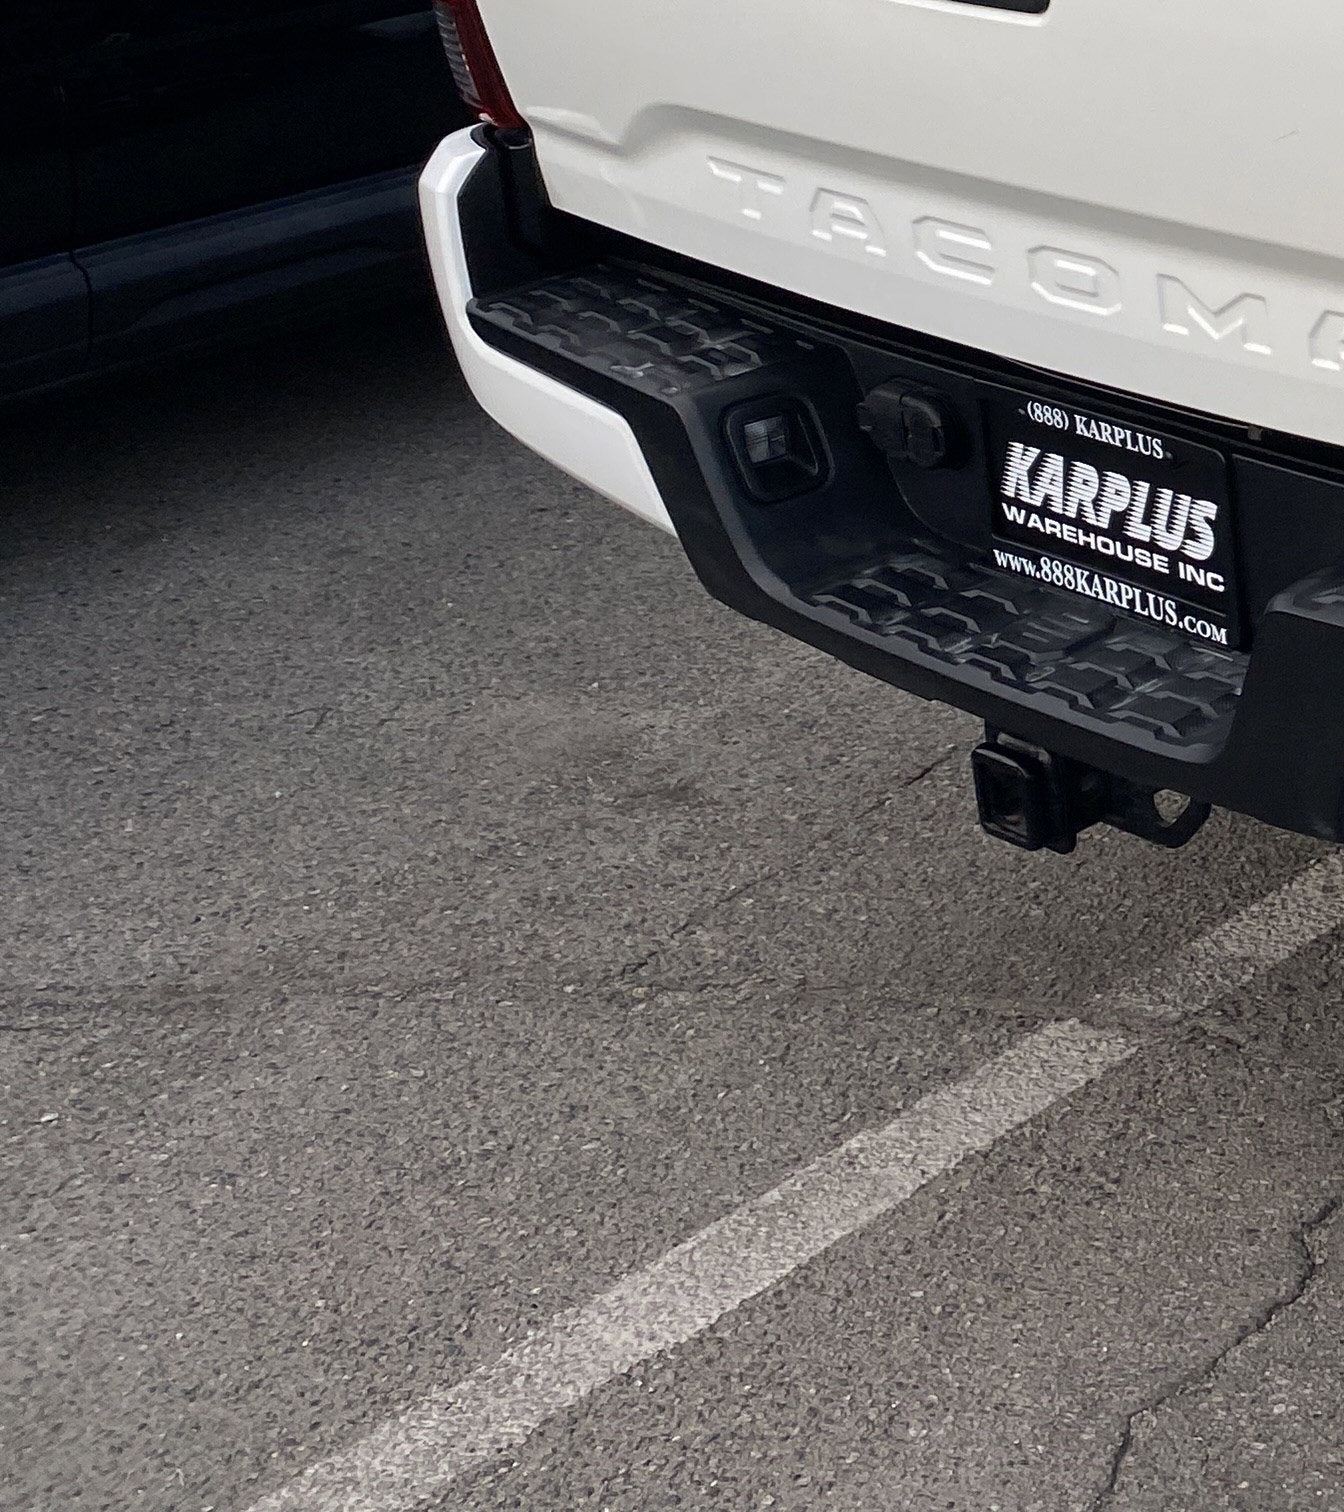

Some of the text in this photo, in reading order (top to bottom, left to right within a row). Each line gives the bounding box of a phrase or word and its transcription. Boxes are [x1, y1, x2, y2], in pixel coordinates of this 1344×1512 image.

[1026, 400, 1164, 459] (888) KARPLUS
[999, 441, 1218, 561] KARPLUS
[1000, 502, 1226, 593] WAREHOUSE INC
